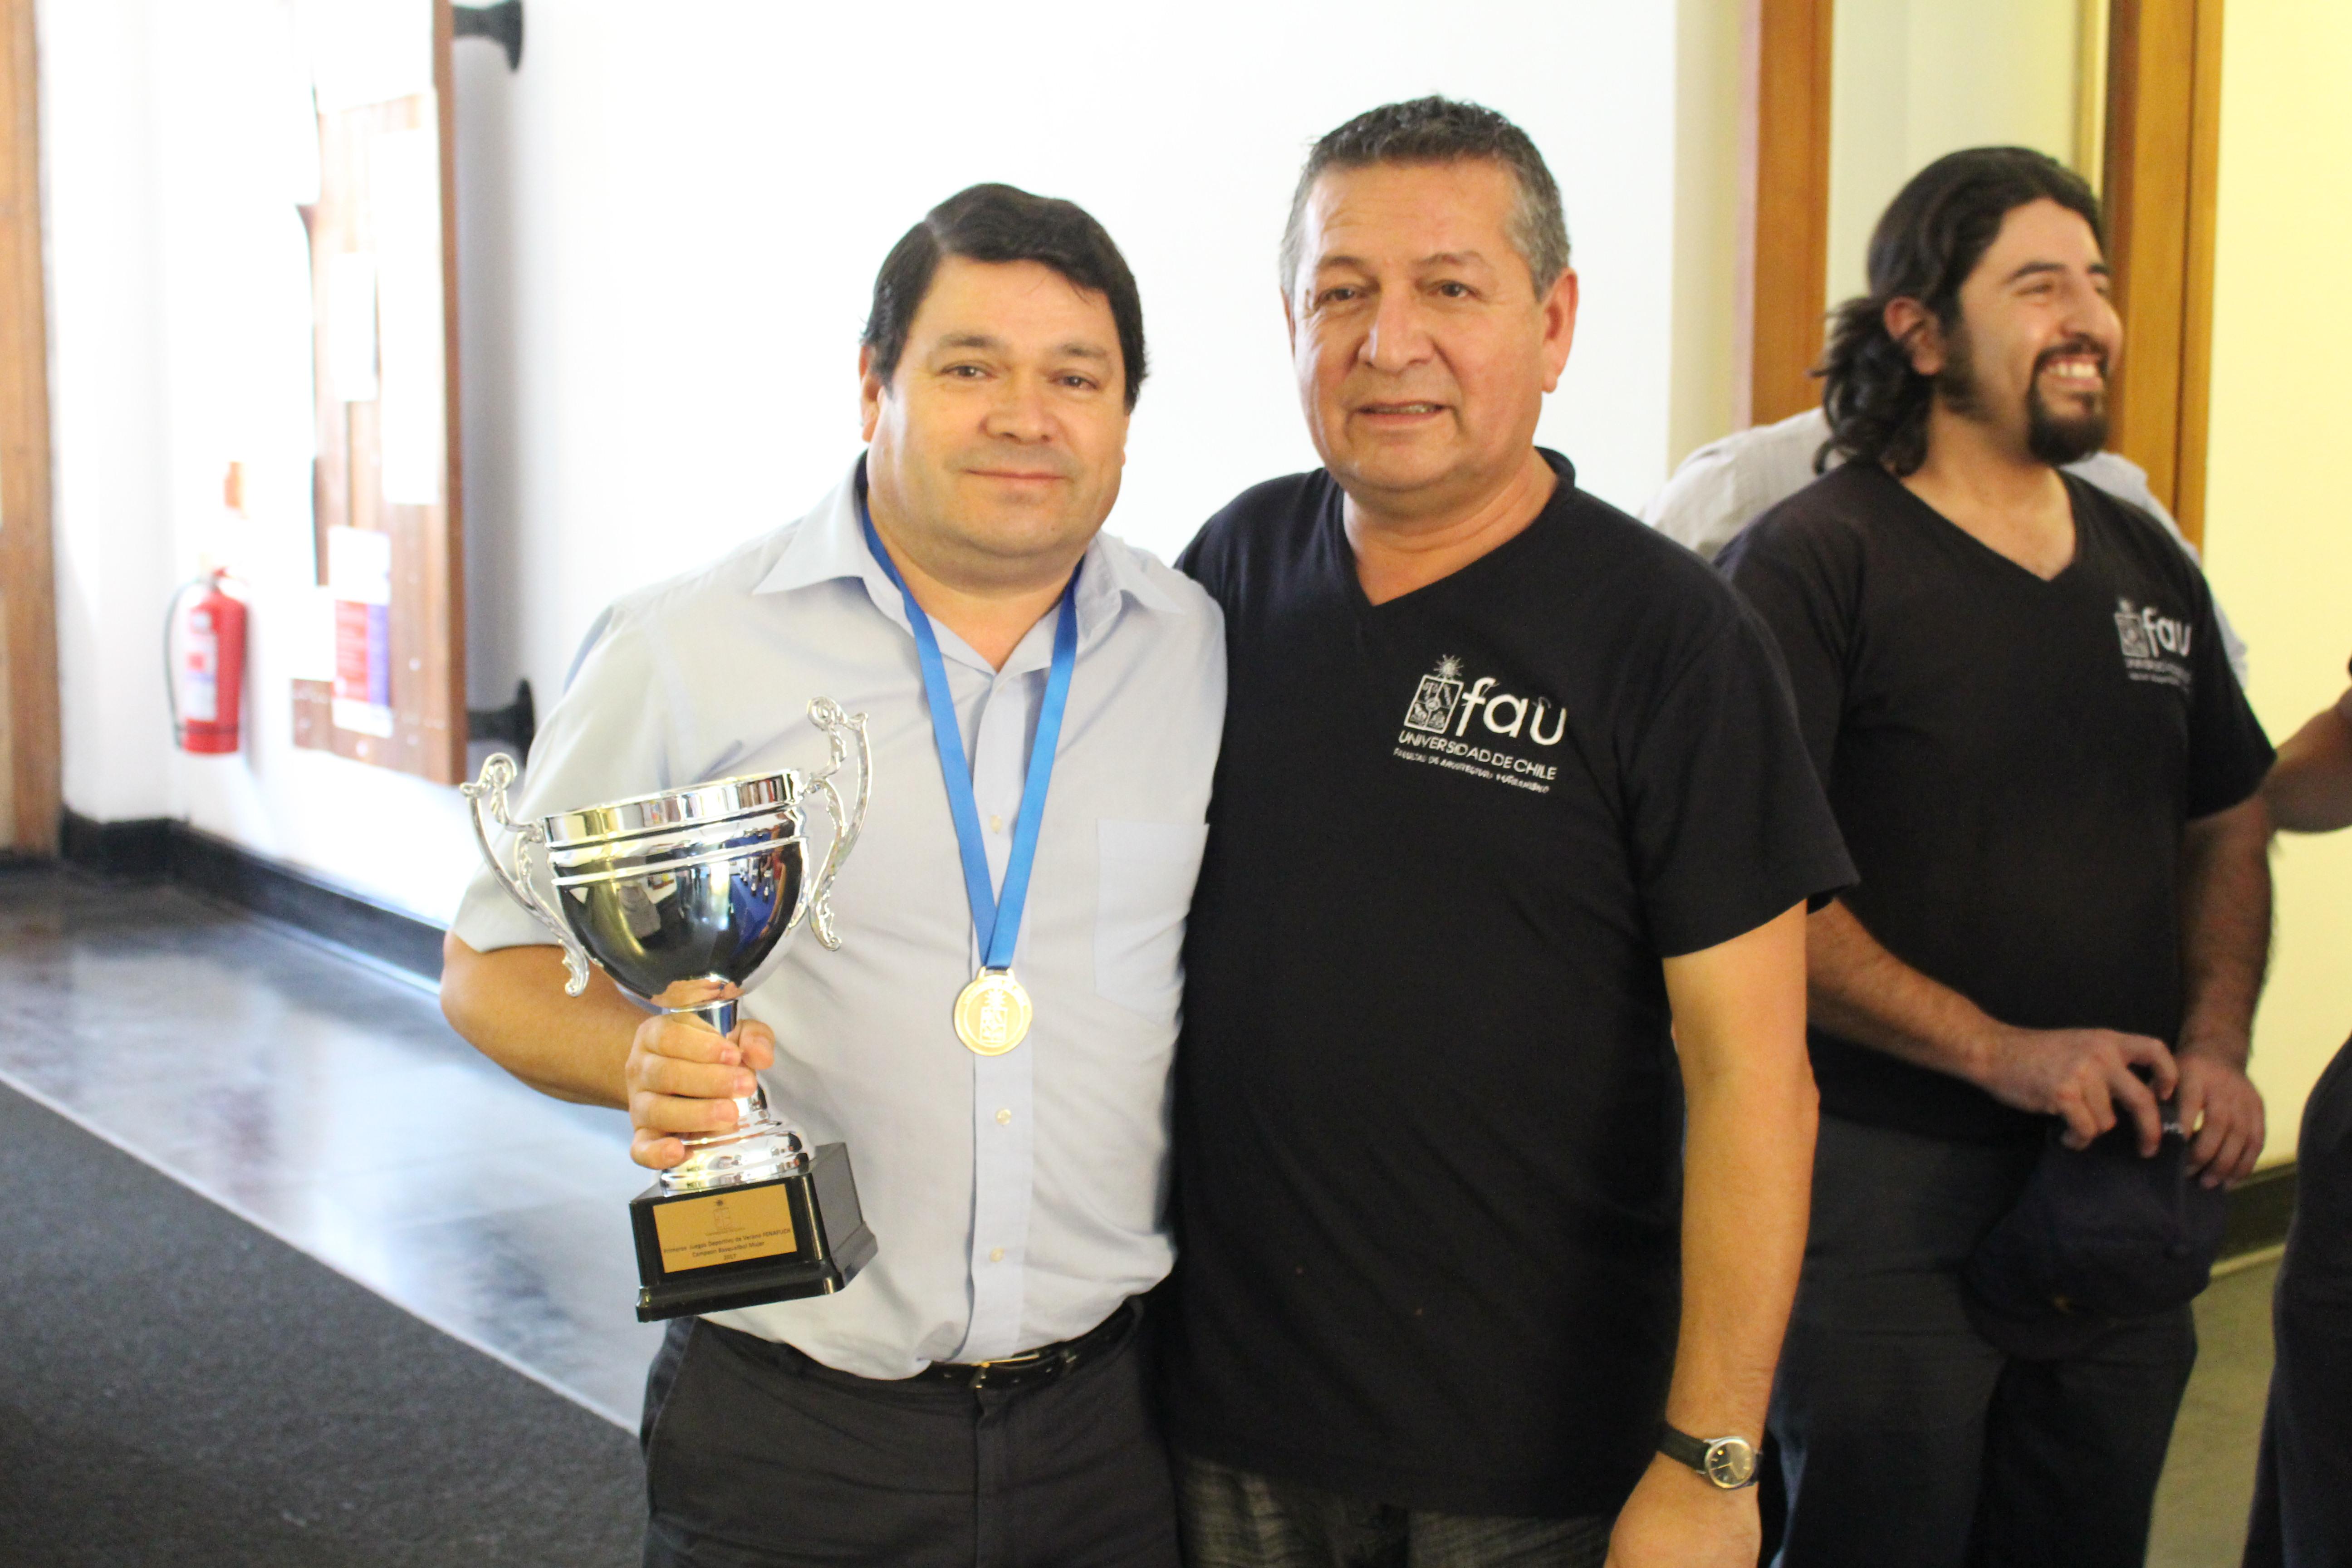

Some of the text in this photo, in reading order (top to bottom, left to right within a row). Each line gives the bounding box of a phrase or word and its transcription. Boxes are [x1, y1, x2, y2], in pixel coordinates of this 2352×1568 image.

[2142, 606, 2192, 657] fau
[1455, 677, 1567, 745] fau
[1398, 730, 1558, 780] UNIVERSIDAD DE CHILE
